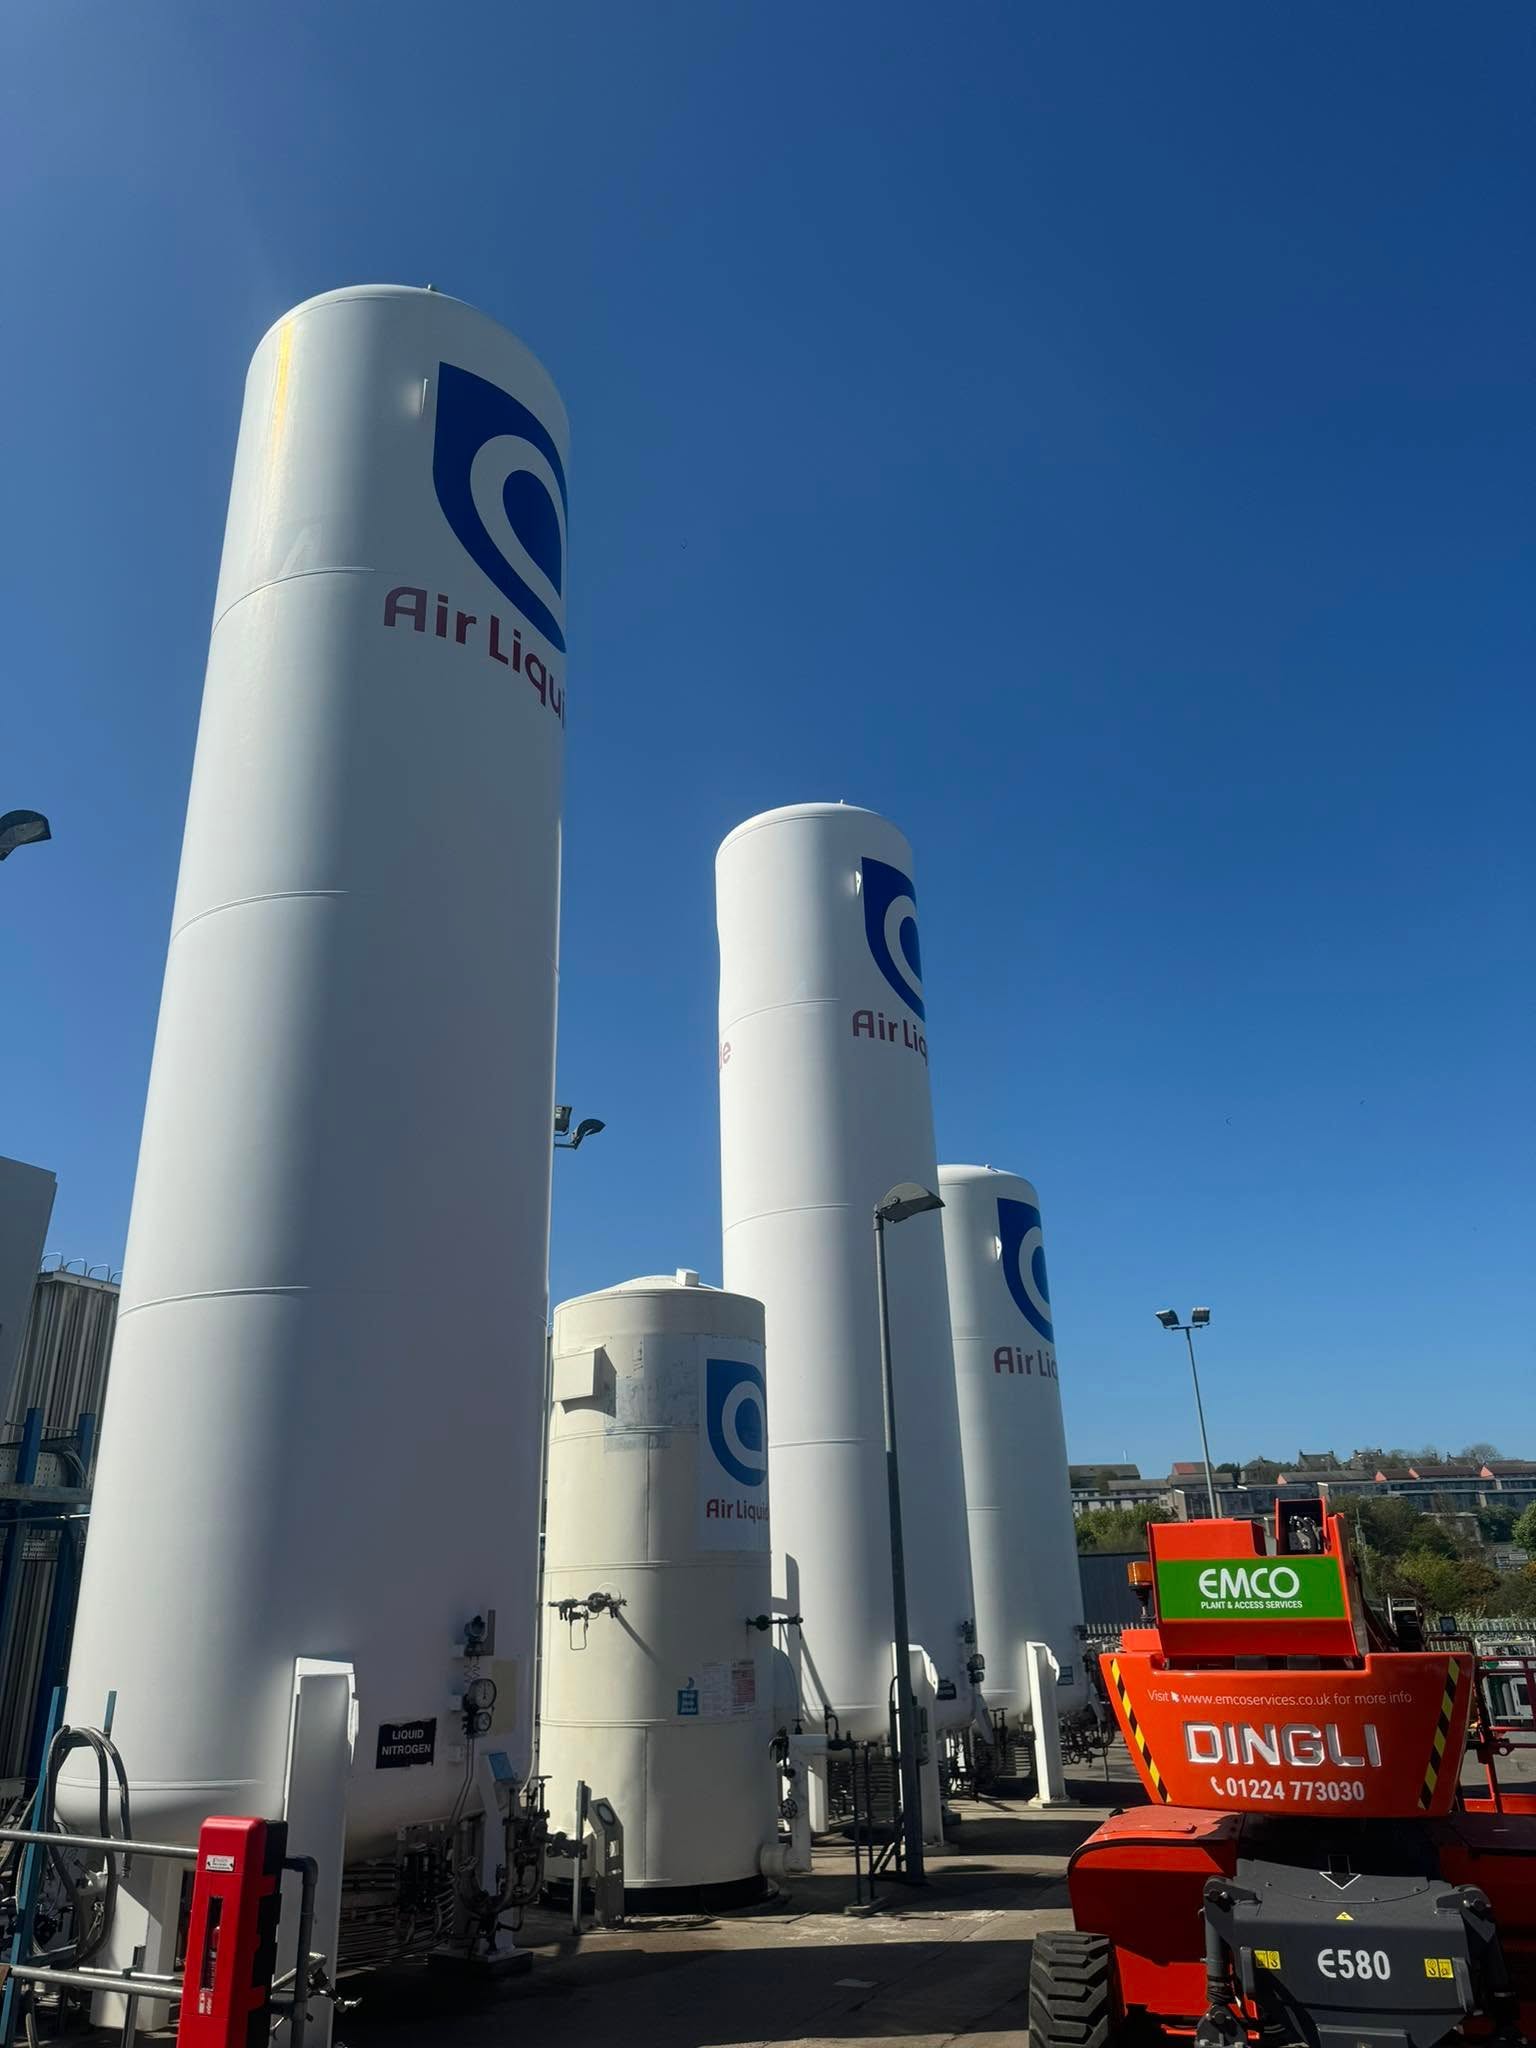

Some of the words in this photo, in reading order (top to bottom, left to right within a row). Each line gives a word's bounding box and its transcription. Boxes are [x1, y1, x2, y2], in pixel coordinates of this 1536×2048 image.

[383, 586, 477, 645] Air
[852, 1009, 898, 1042] Air
[993, 1346, 1034, 1375] Air
[706, 1498, 734, 1519] Air
[1198, 1566, 1300, 1599] EMCO
[1200, 1601, 1226, 1610] PLANT
[1227, 1601, 1233, 1609] &
[1234, 1601, 1264, 1609] ACCESS
[1265, 1600, 1303, 1609] SERVICES
[1147, 1689, 1170, 1702] Visit
[1182, 1693, 1331, 1706] www.emcoservices.co.uk
[1334, 1692, 1351, 1705] for
[1354, 1694, 1387, 1705] more
[1389, 1690, 1412, 1704] info
[392, 1729, 425, 1740] LIQUID
[1184, 1721, 1382, 1768] DINGLI
[381, 1743, 432, 1756] NITROGEN
[1226, 1776, 1286, 1801] 01224
[1289, 1780, 1366, 1801] 773030
[1317, 1948, 1392, 1981] E580
